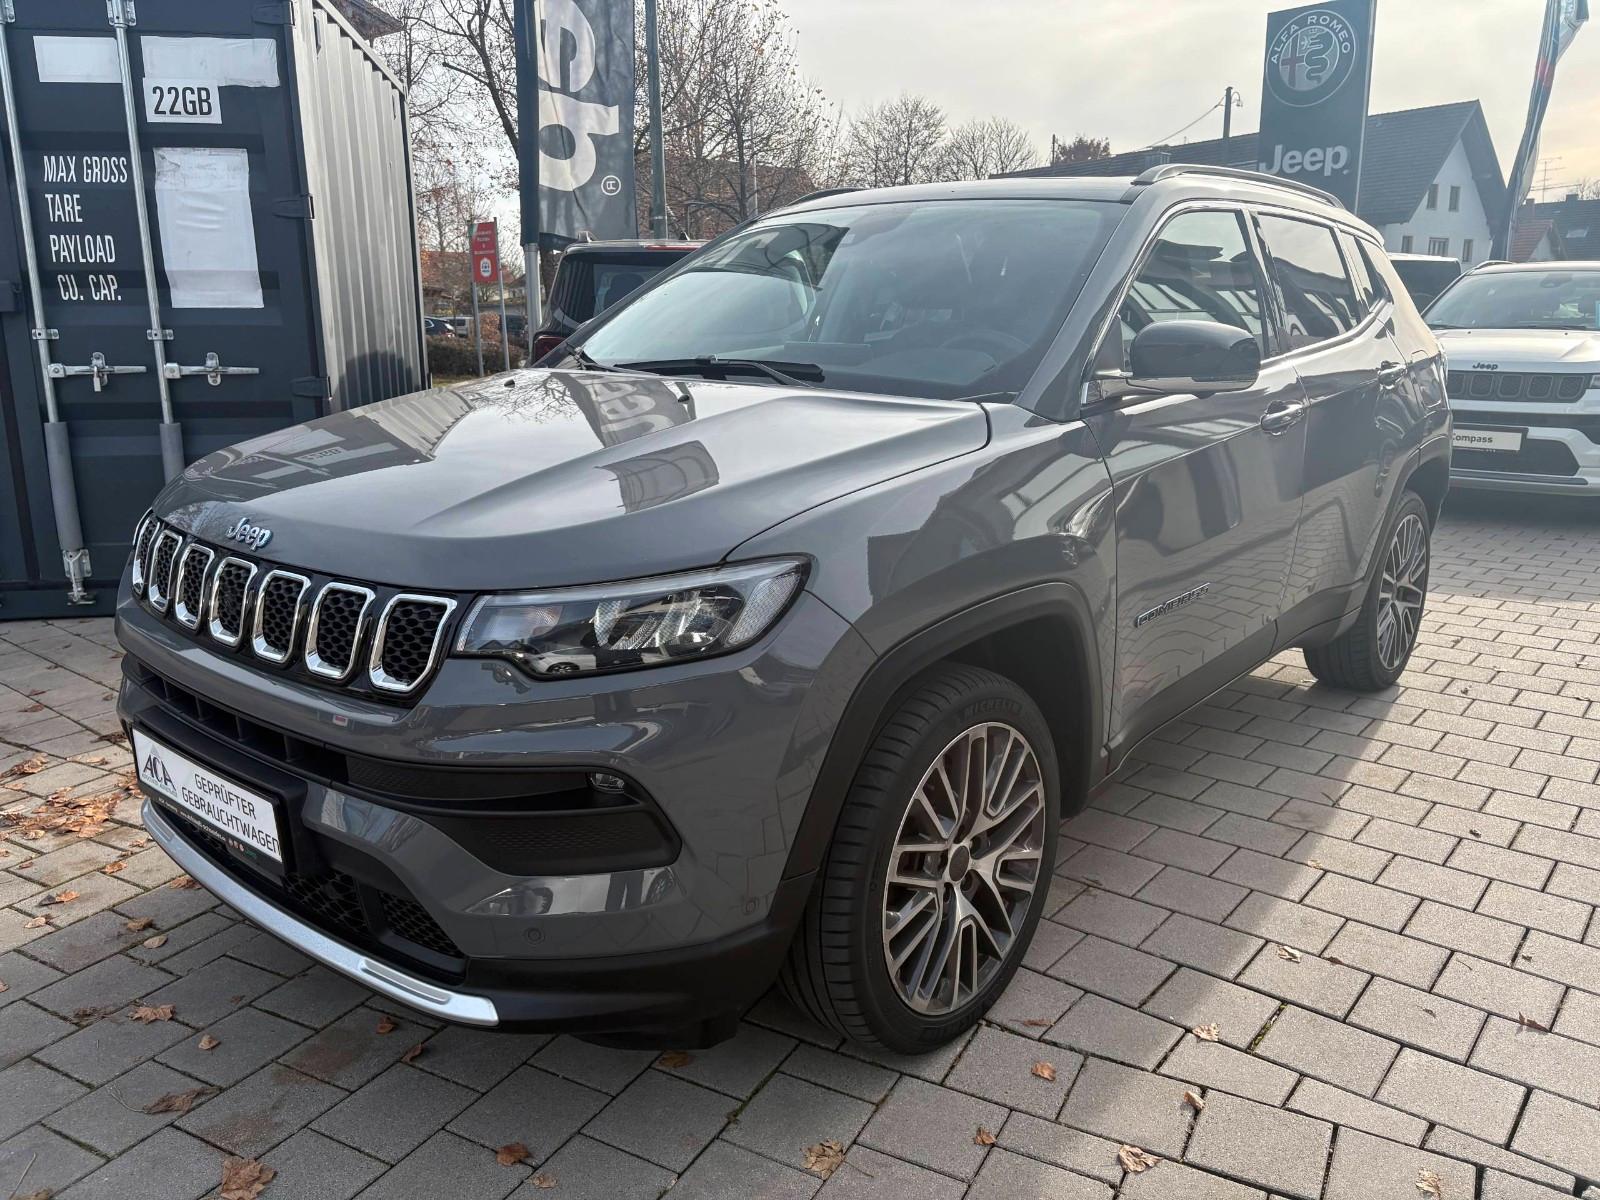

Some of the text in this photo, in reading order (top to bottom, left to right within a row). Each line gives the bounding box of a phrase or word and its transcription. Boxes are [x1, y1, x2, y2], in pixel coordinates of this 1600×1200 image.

[1271, 15, 1351, 64] ALFA ROMEO
[151, 86, 213, 117] 22GB
[43, 155, 128, 184] MAX GROSS
[45, 193, 83, 223] TARE
[49, 234, 116, 264] PAYLOAD
[57, 274, 122, 301] CU. CAP.
[1472, 362, 1499, 371] Jeep
[225, 517, 273, 551] Jeep
[143, 754, 177, 791] ACA
[194, 773, 257, 820] GEPRÜFTER
[181, 786, 281, 857] GEBRAUCHTWAGEN
